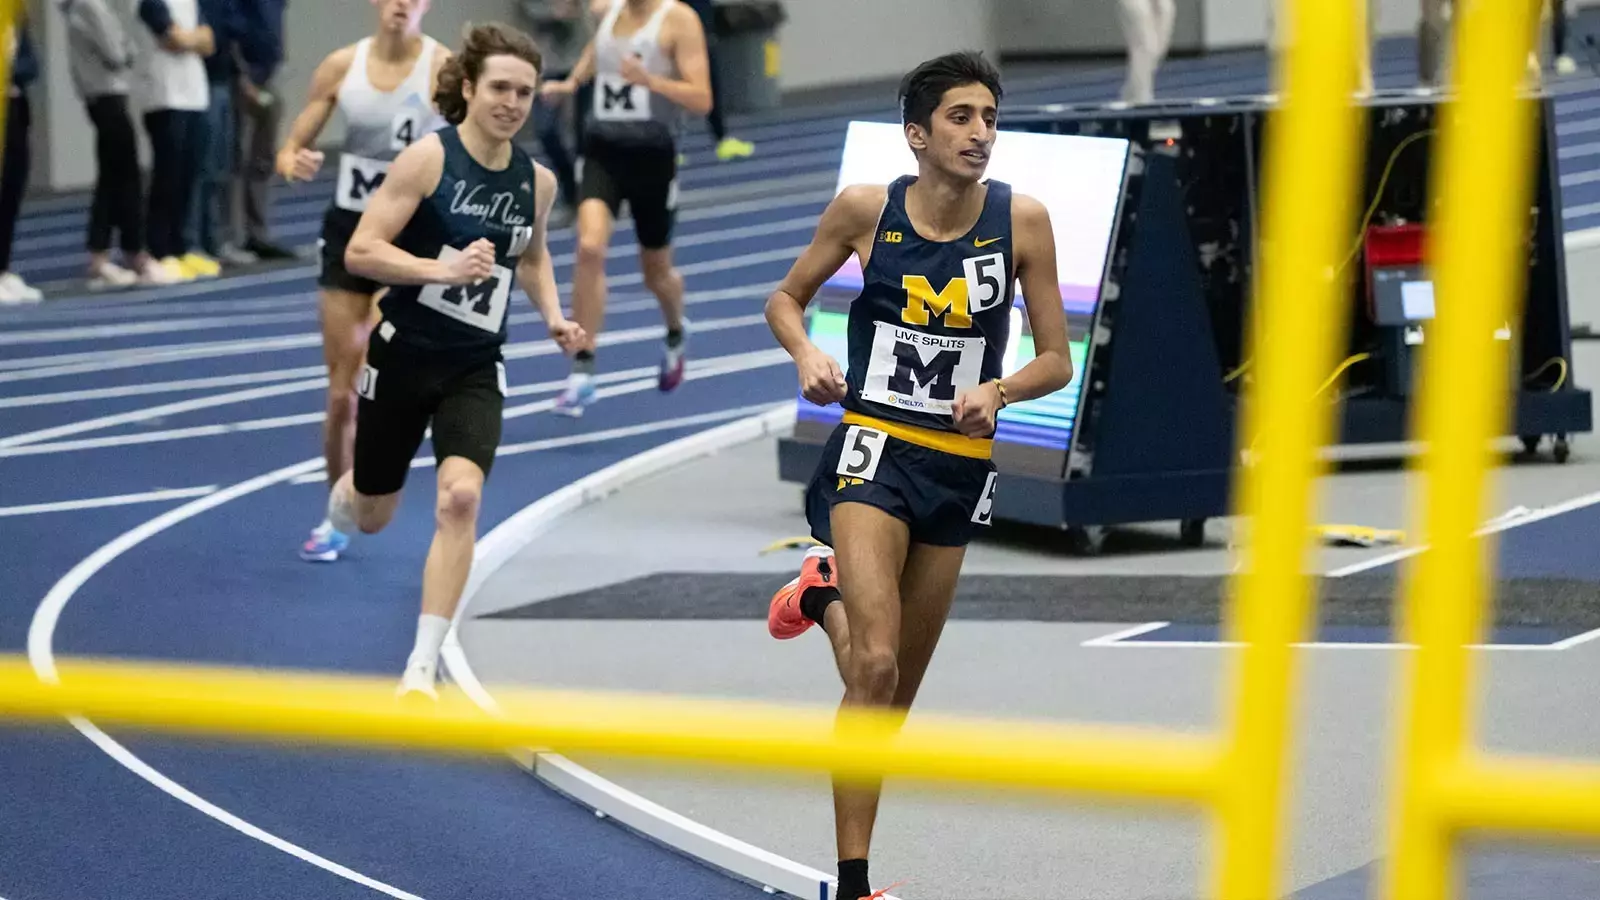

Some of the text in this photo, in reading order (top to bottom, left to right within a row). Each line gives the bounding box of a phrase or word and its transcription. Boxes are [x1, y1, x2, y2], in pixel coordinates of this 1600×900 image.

[396, 119, 412, 147] 4
[901, 274, 973, 329] M
[974, 257, 1000, 308] 5
[894, 329, 965, 349] LIVE SPLITS
[887, 340, 962, 401] M
[846, 429, 879, 474] 5
